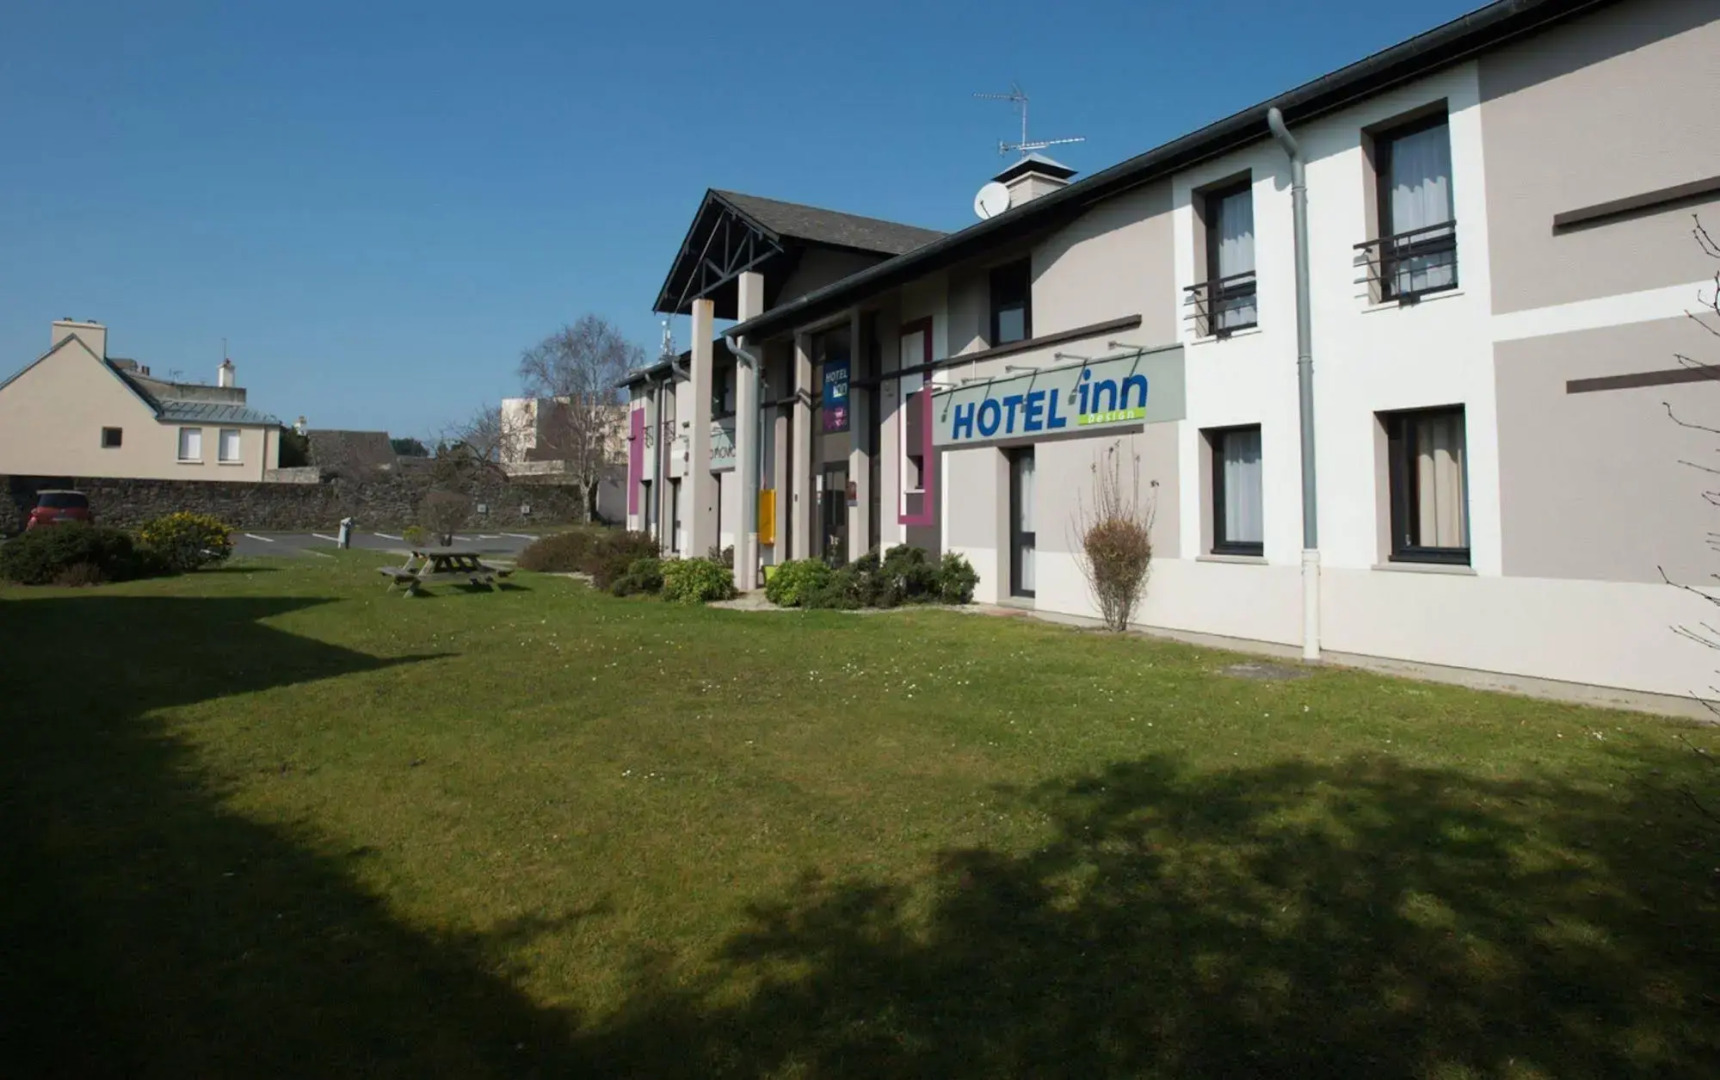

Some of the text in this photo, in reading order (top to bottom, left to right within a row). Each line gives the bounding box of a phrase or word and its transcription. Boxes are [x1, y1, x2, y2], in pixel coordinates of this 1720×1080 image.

[825, 368, 848, 382] HOTEL
[952, 369, 1148, 439] HOTEL inn
